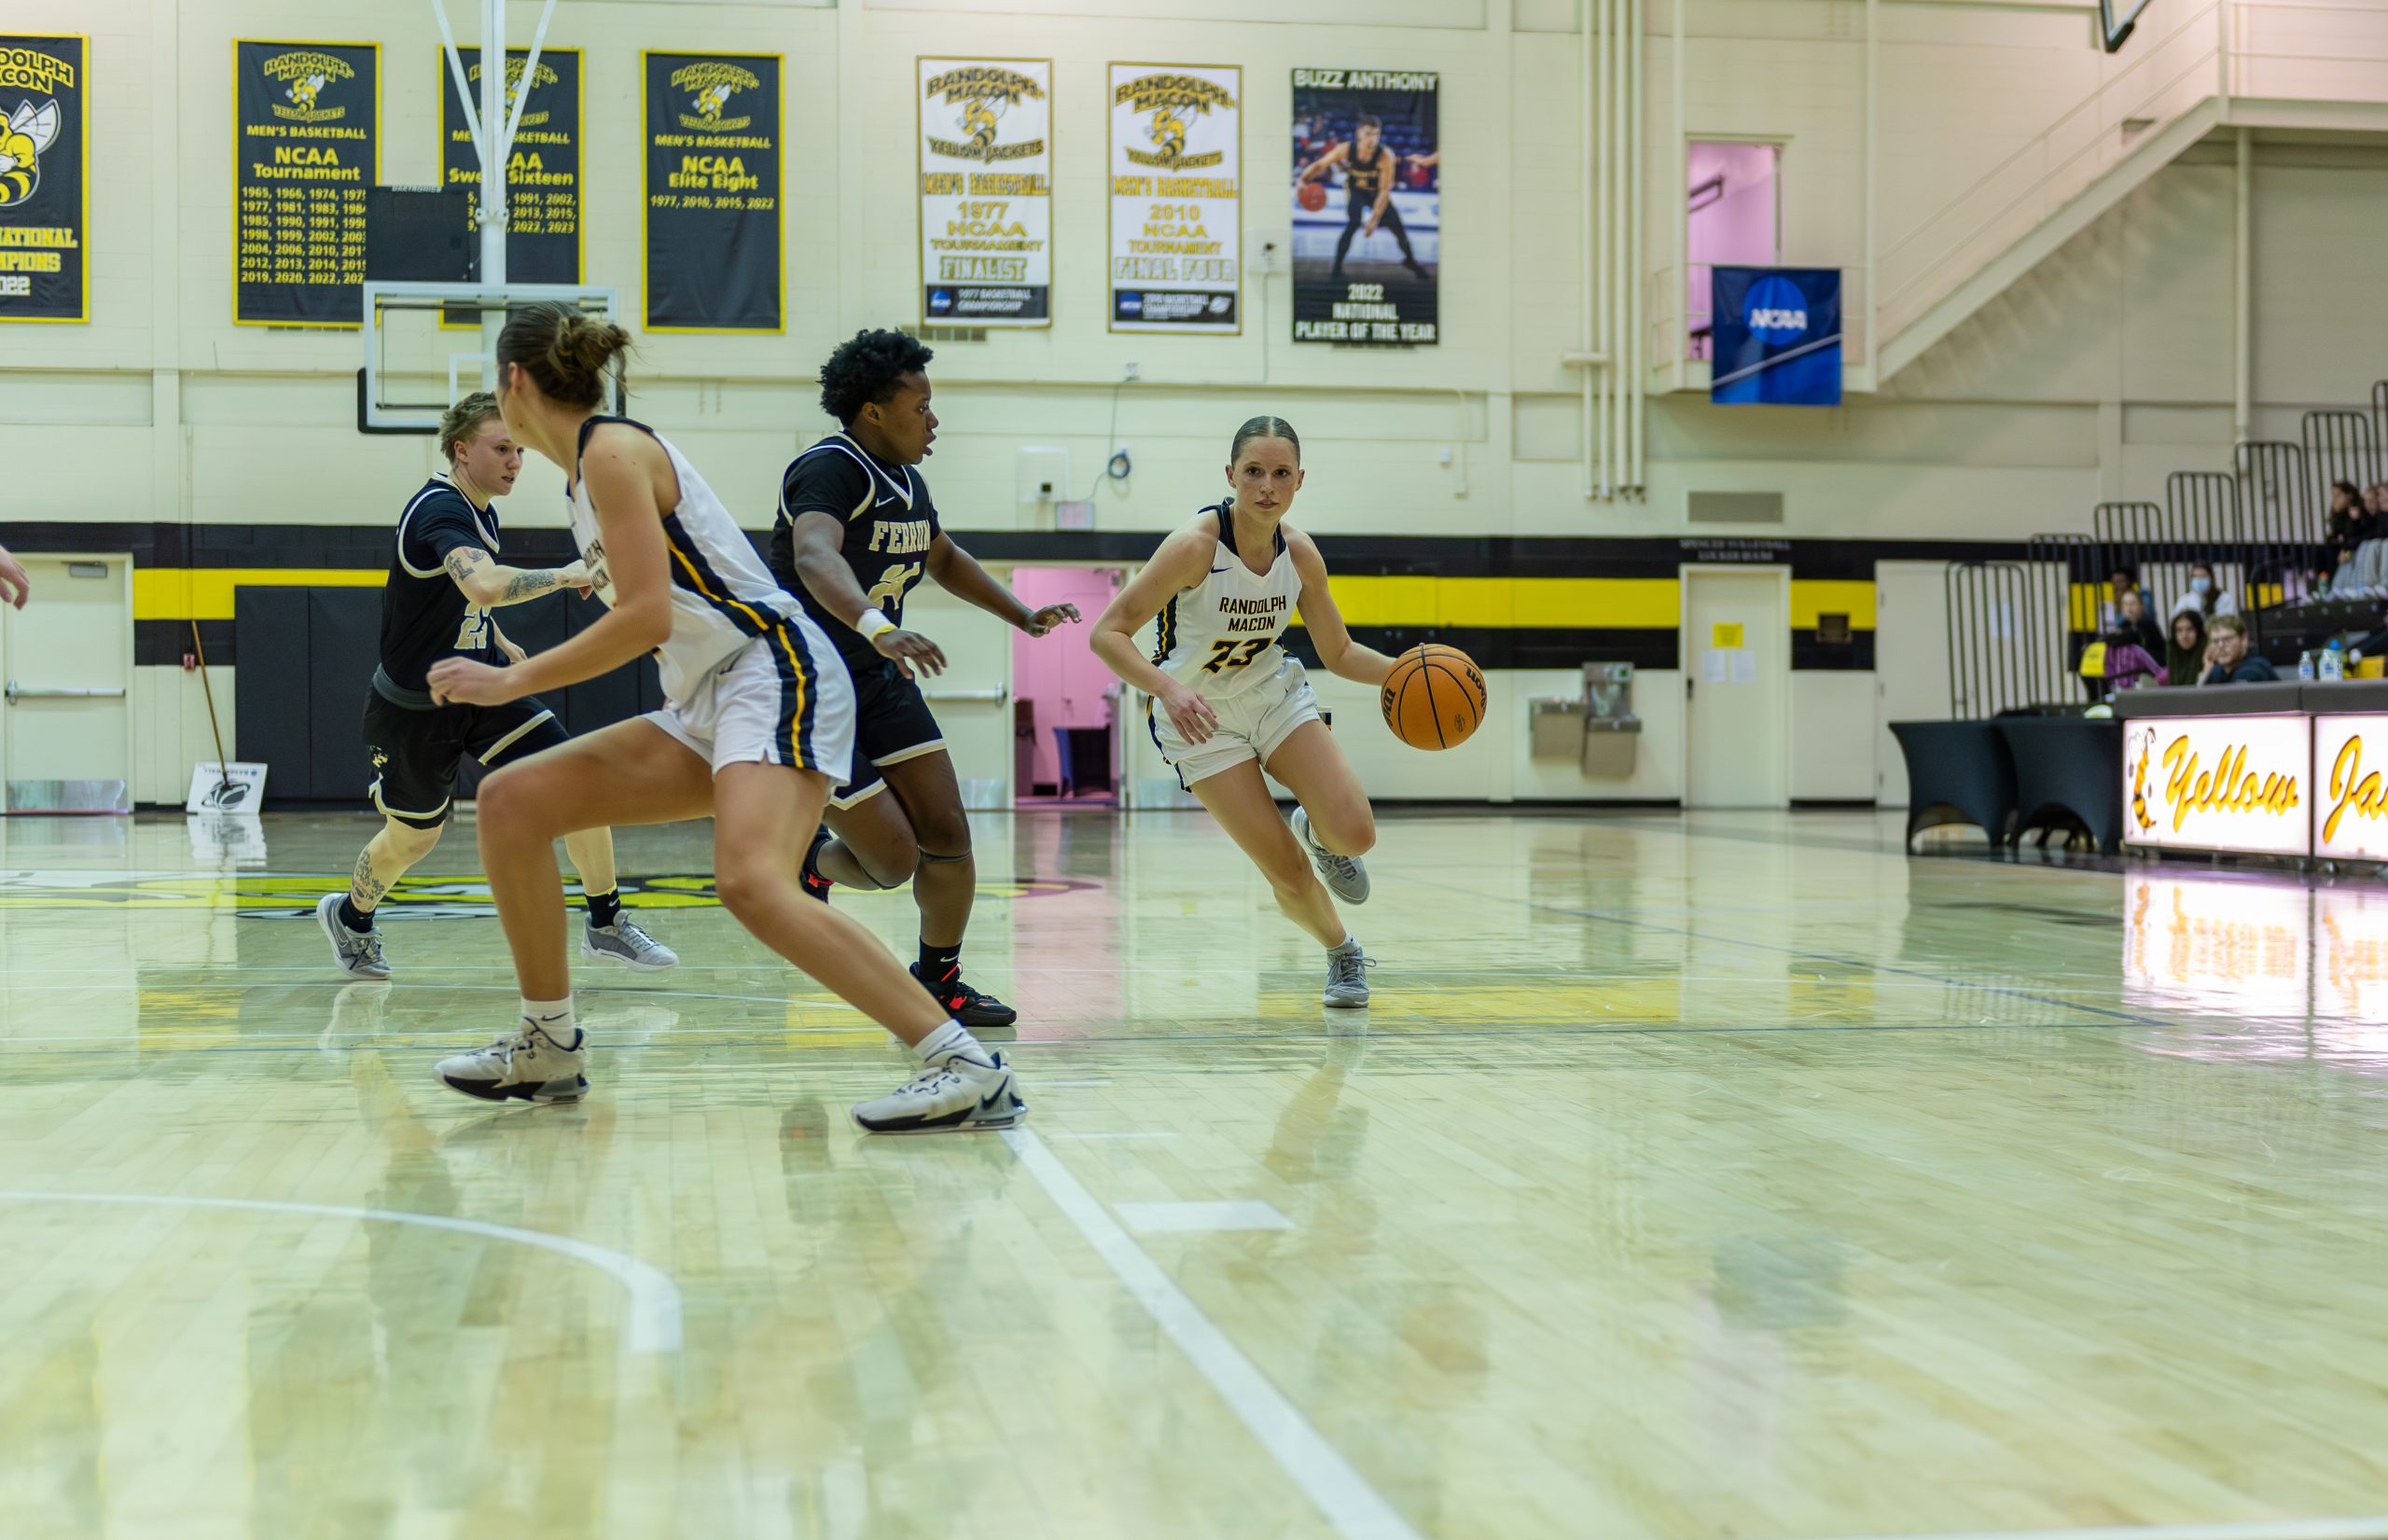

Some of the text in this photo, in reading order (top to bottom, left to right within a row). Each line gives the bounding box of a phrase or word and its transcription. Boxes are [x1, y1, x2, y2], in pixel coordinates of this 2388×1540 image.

[264, 51, 351, 78] RANDOLPH
[278, 64, 336, 83] MACON
[0, 67, 53, 95] CON
[926, 66, 1038, 100] RANDOLPH
[1294, 69, 1438, 90] BUZZ ANTHONY
[946, 79, 1021, 104] MACON
[1116, 74, 1229, 110] RANDOLPH
[1134, 90, 1211, 115] MACON
[246, 124, 367, 139] MEN'S BASKETBALL
[513, 132, 570, 144] SKETBALL
[655, 133, 772, 149] MEN'S BASKETBALL
[274, 146, 340, 165] NCAA
[506, 152, 543, 171] AA
[682, 156, 745, 174] NCAA
[253, 162, 361, 180] Tournament
[449, 168, 574, 187] Swe Sixteen
[669, 172, 759, 192] Elite Eight
[968, 173, 1049, 196] BASKETBALL
[1113, 175, 1238, 199] MEN'S BASKETBALL
[957, 200, 1009, 219] 1977
[1148, 203, 1201, 222] 2010
[0, 227, 78, 248] ATIONAL
[947, 221, 1029, 237] NCAA
[1143, 224, 1209, 239] NCAA
[930, 238, 1045, 251] TOURNAMENT
[1128, 239, 1223, 255] TOURNAMENT
[940, 255, 1028, 282] FINALIST
[1114, 256, 1237, 282] FINAL FOUR
[342, 272, 365, 285] 202
[1347, 283, 1384, 300] 2022
[1332, 301, 1399, 320] NATIONAL
[1750, 308, 1808, 330] NCAA
[1296, 321, 1437, 340] PLAYER OF THE YEAR
[1218, 595, 1286, 615] RANDOLPH
[1228, 616, 1275, 631] MACON
[1201, 637, 1273, 675] 23
[2162, 734, 2388, 846] Yellow Ja
